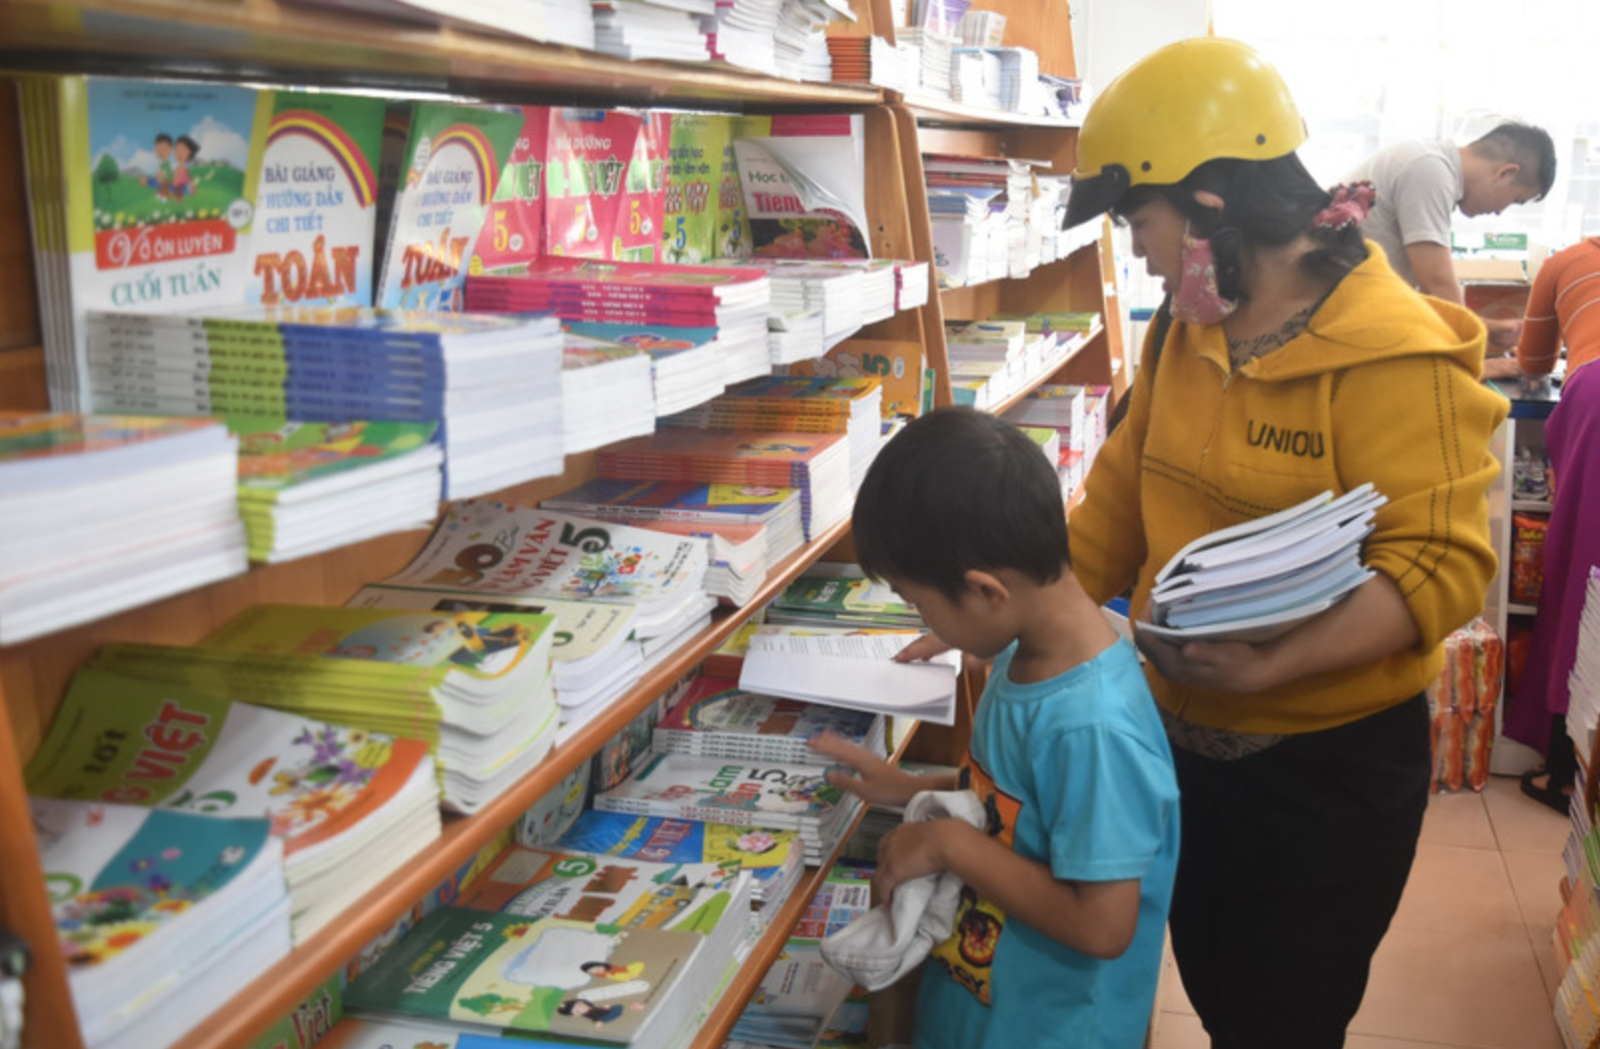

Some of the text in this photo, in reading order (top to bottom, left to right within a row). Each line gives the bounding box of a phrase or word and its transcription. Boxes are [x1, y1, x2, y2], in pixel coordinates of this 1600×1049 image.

[265, 161, 335, 184] BÀI GIẢNG
[265, 182, 344, 209] HƯỚNG DẪN
[266, 207, 324, 234] CHI TIẾT
[493, 208, 508, 252] 5
[630, 200, 640, 235] 5
[178, 229, 223, 257] LUYỆN
[676, 217, 686, 250] 5
[254, 233, 360, 304] TOÁN
[111, 260, 223, 308] CUỐI TUẦN
[862, 353, 891, 376] 5
[1247, 419, 1325, 459] UNIOU
[559, 521, 611, 554] 5
[124, 700, 209, 780] VIỆT
[748, 769, 788, 784] 5
[556, 861, 589, 874] 5
[472, 921, 494, 932] 5
